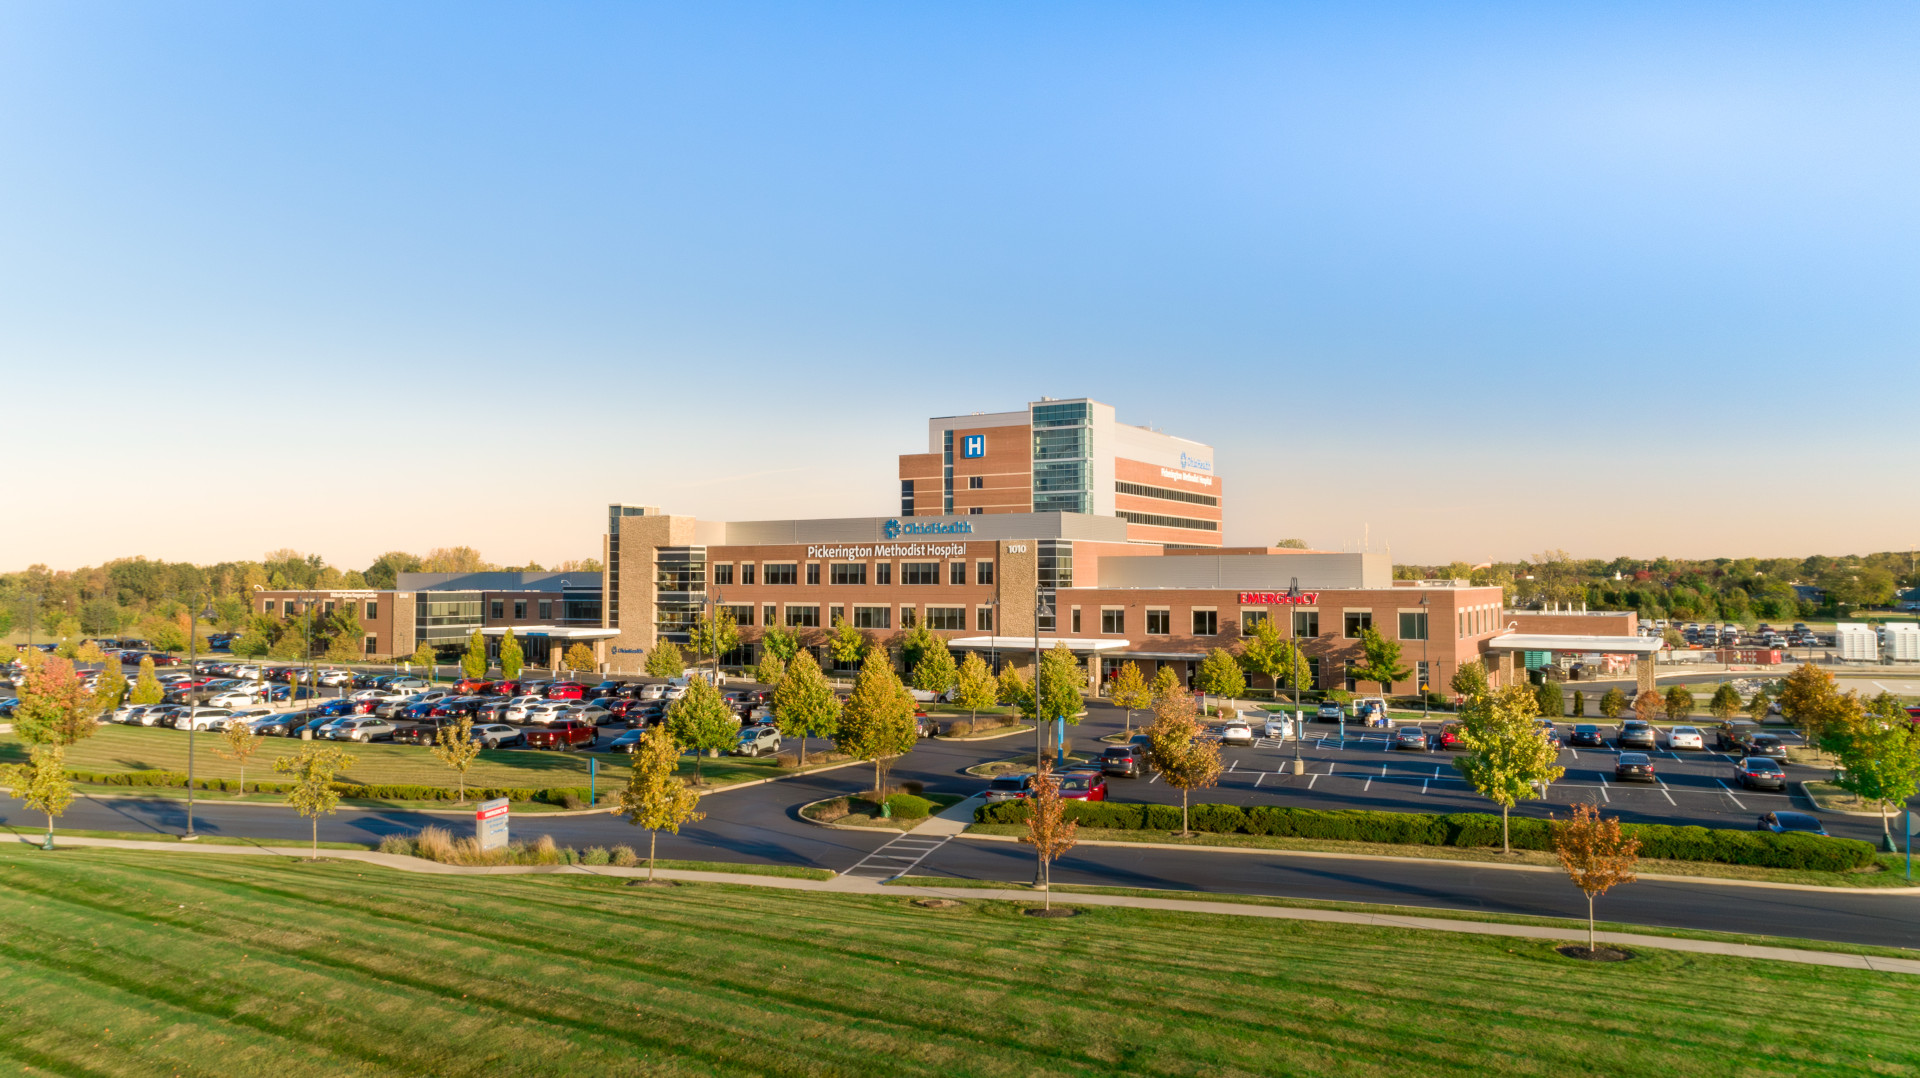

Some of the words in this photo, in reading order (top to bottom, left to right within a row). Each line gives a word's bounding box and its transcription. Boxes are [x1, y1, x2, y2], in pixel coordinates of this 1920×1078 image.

[968, 437, 981, 455] H
[904, 521, 974, 534] OhioHealth
[807, 544, 872, 561] Pickerington
[874, 543, 926, 557] Methodist
[927, 542, 967, 558] Hospital
[1008, 544, 1027, 554] 1010
[1240, 592, 1319, 604] EMERGENCY
